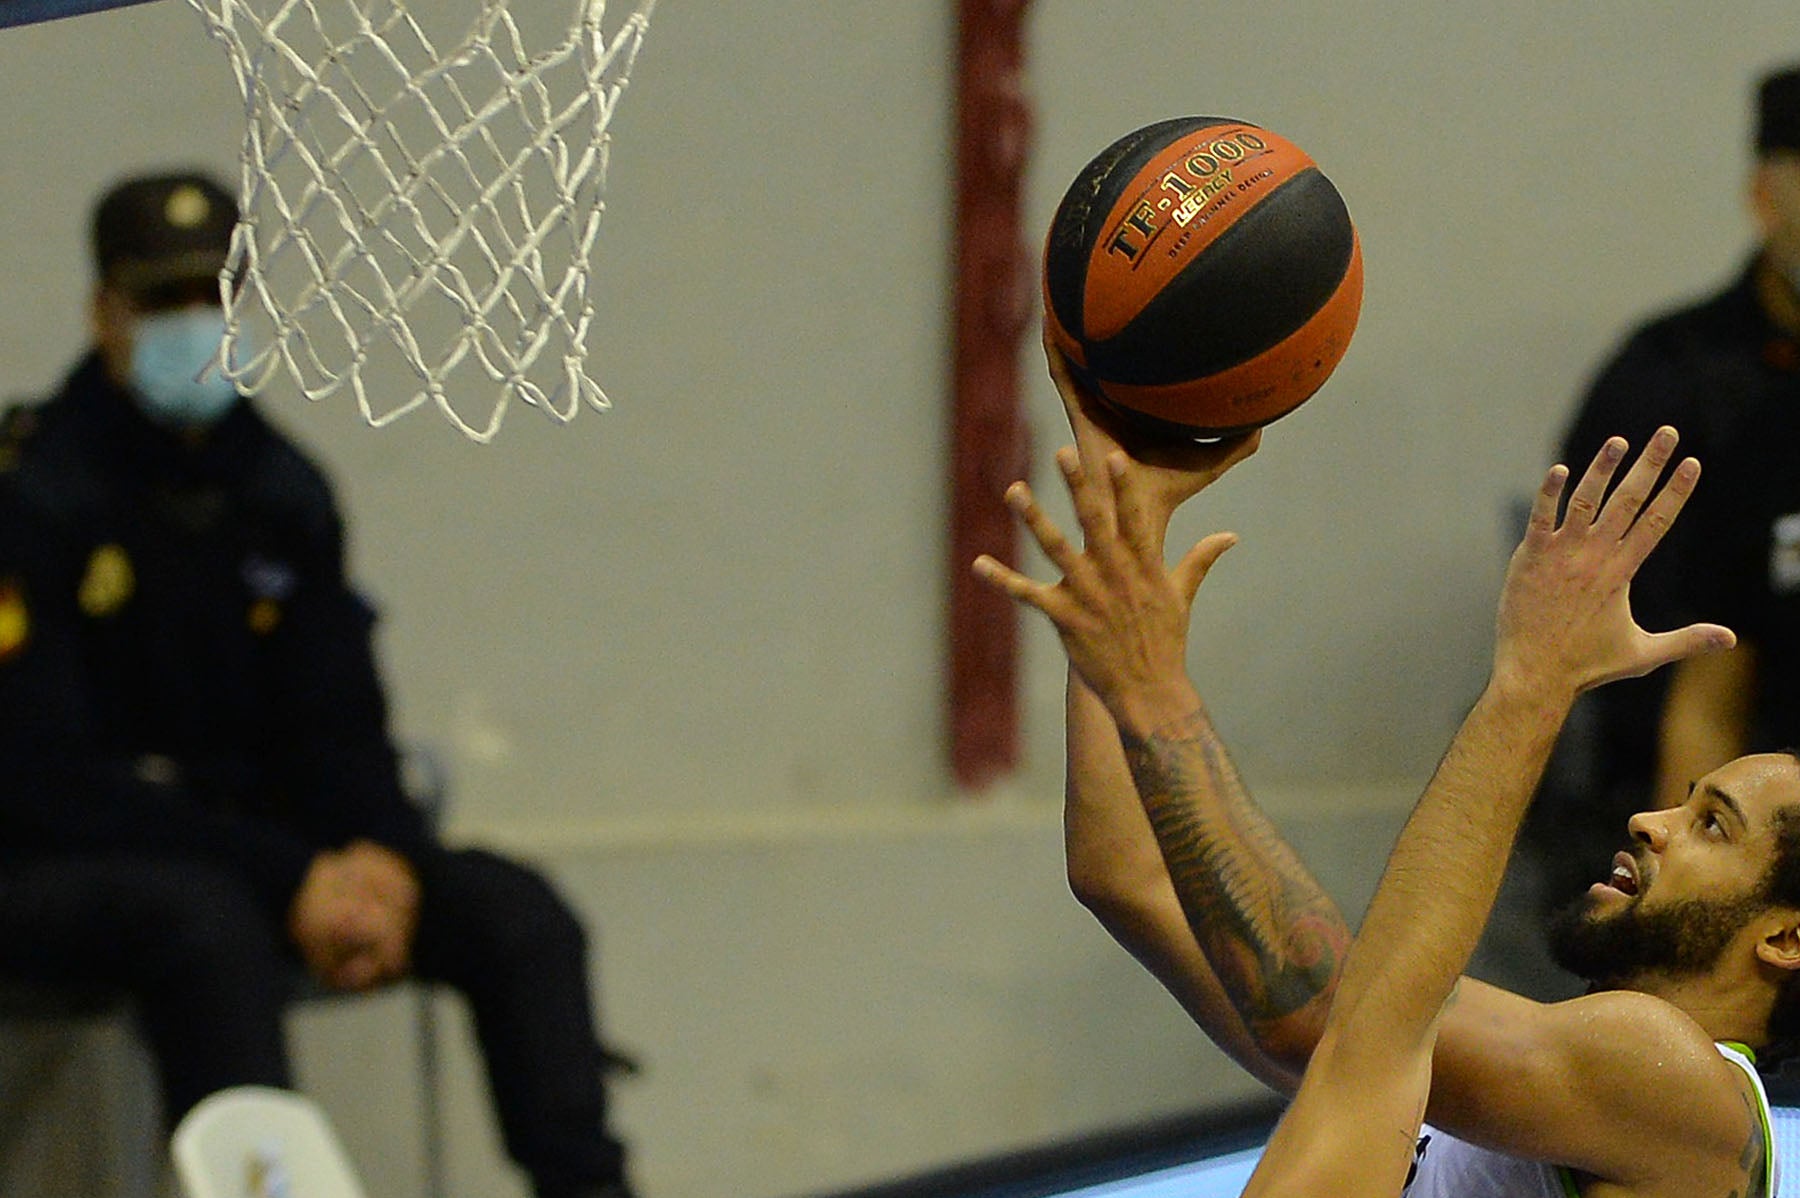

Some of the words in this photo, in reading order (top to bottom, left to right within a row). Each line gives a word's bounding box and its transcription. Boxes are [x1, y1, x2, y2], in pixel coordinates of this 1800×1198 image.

[1108, 132, 1267, 264] TF-1000
[1171, 168, 1235, 228] LEGACY
[1168, 231, 1192, 259] DEEP
